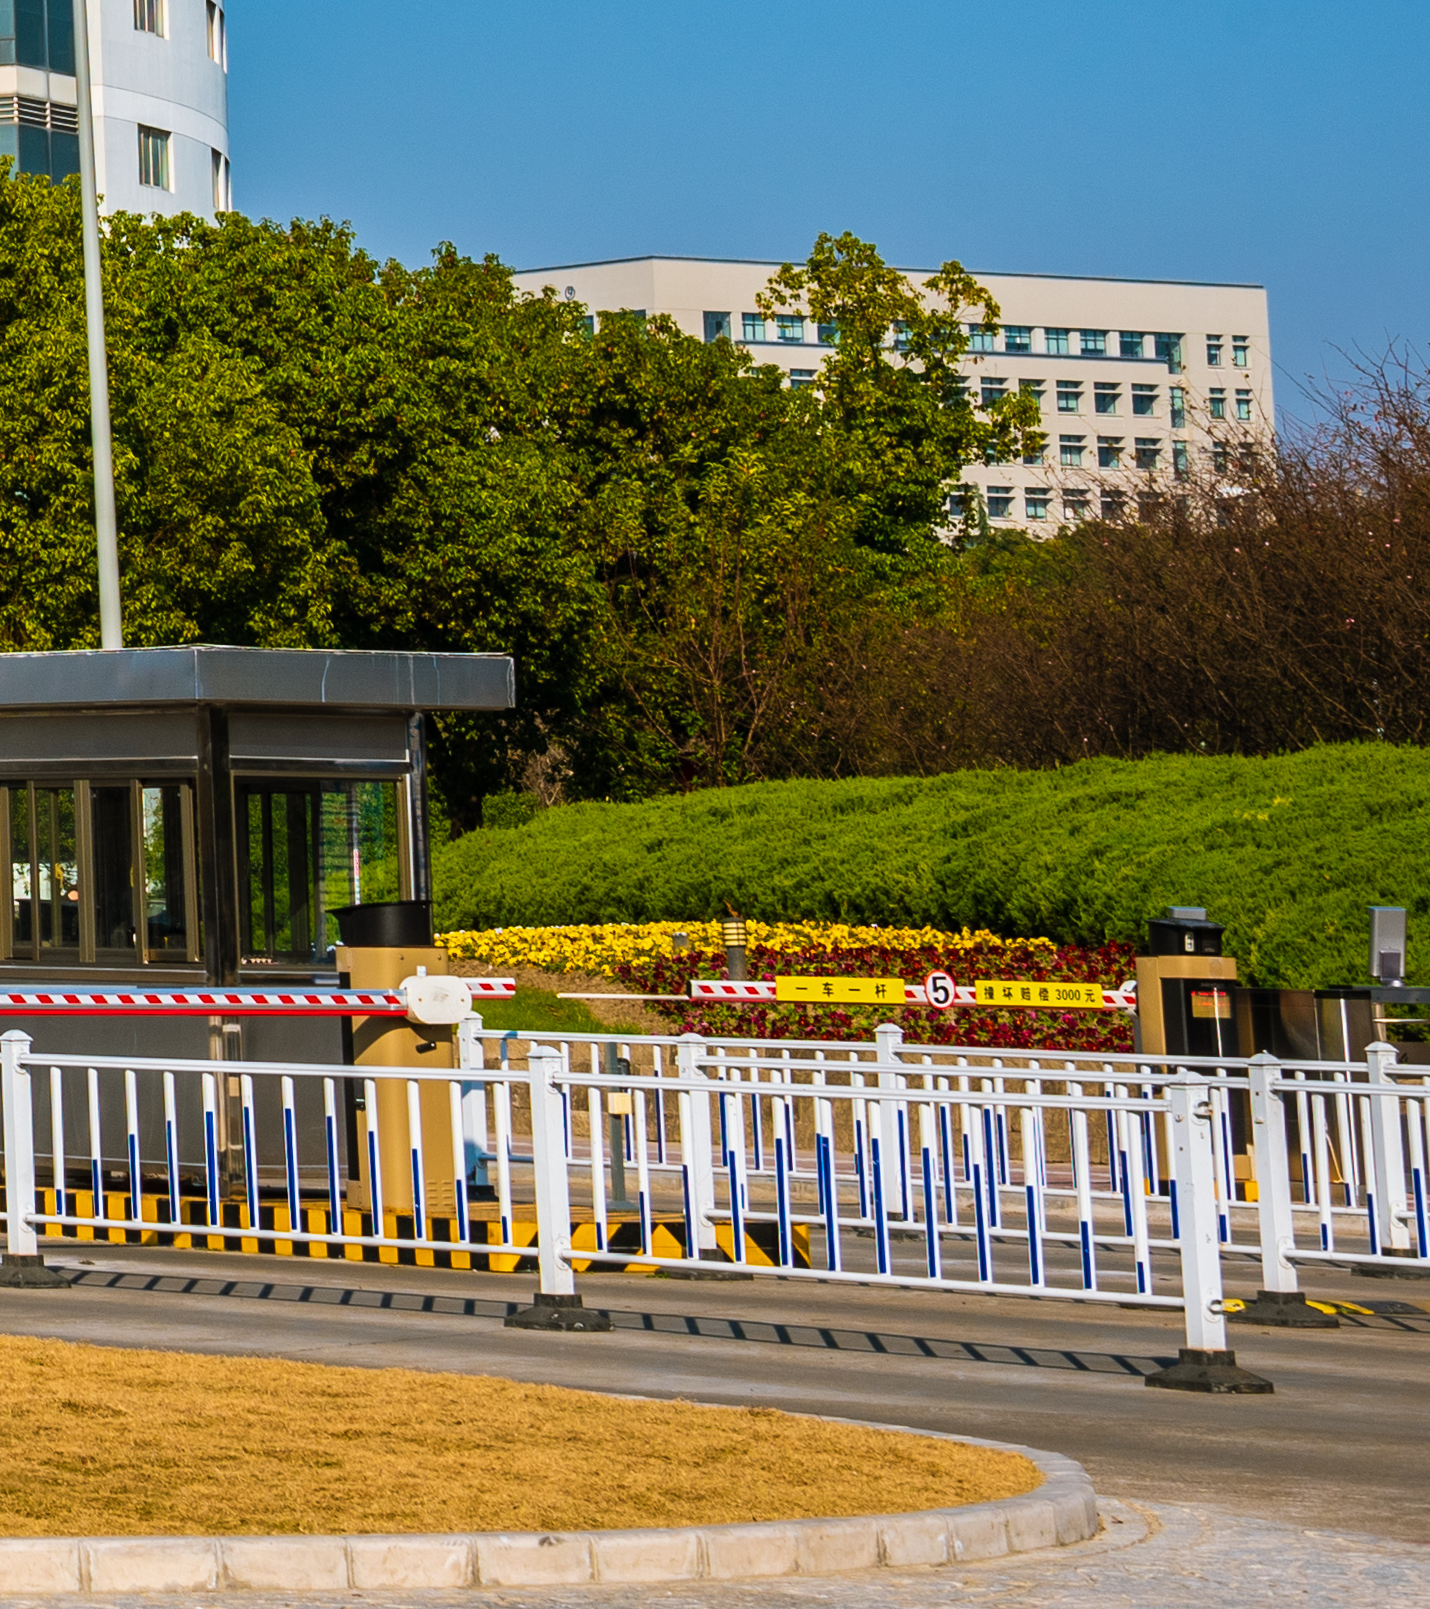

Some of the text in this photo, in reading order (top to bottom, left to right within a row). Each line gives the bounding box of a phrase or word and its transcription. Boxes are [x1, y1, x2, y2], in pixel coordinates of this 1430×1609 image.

[795, 981, 887, 999] 一车一杆
[931, 976, 950, 1005] 5
